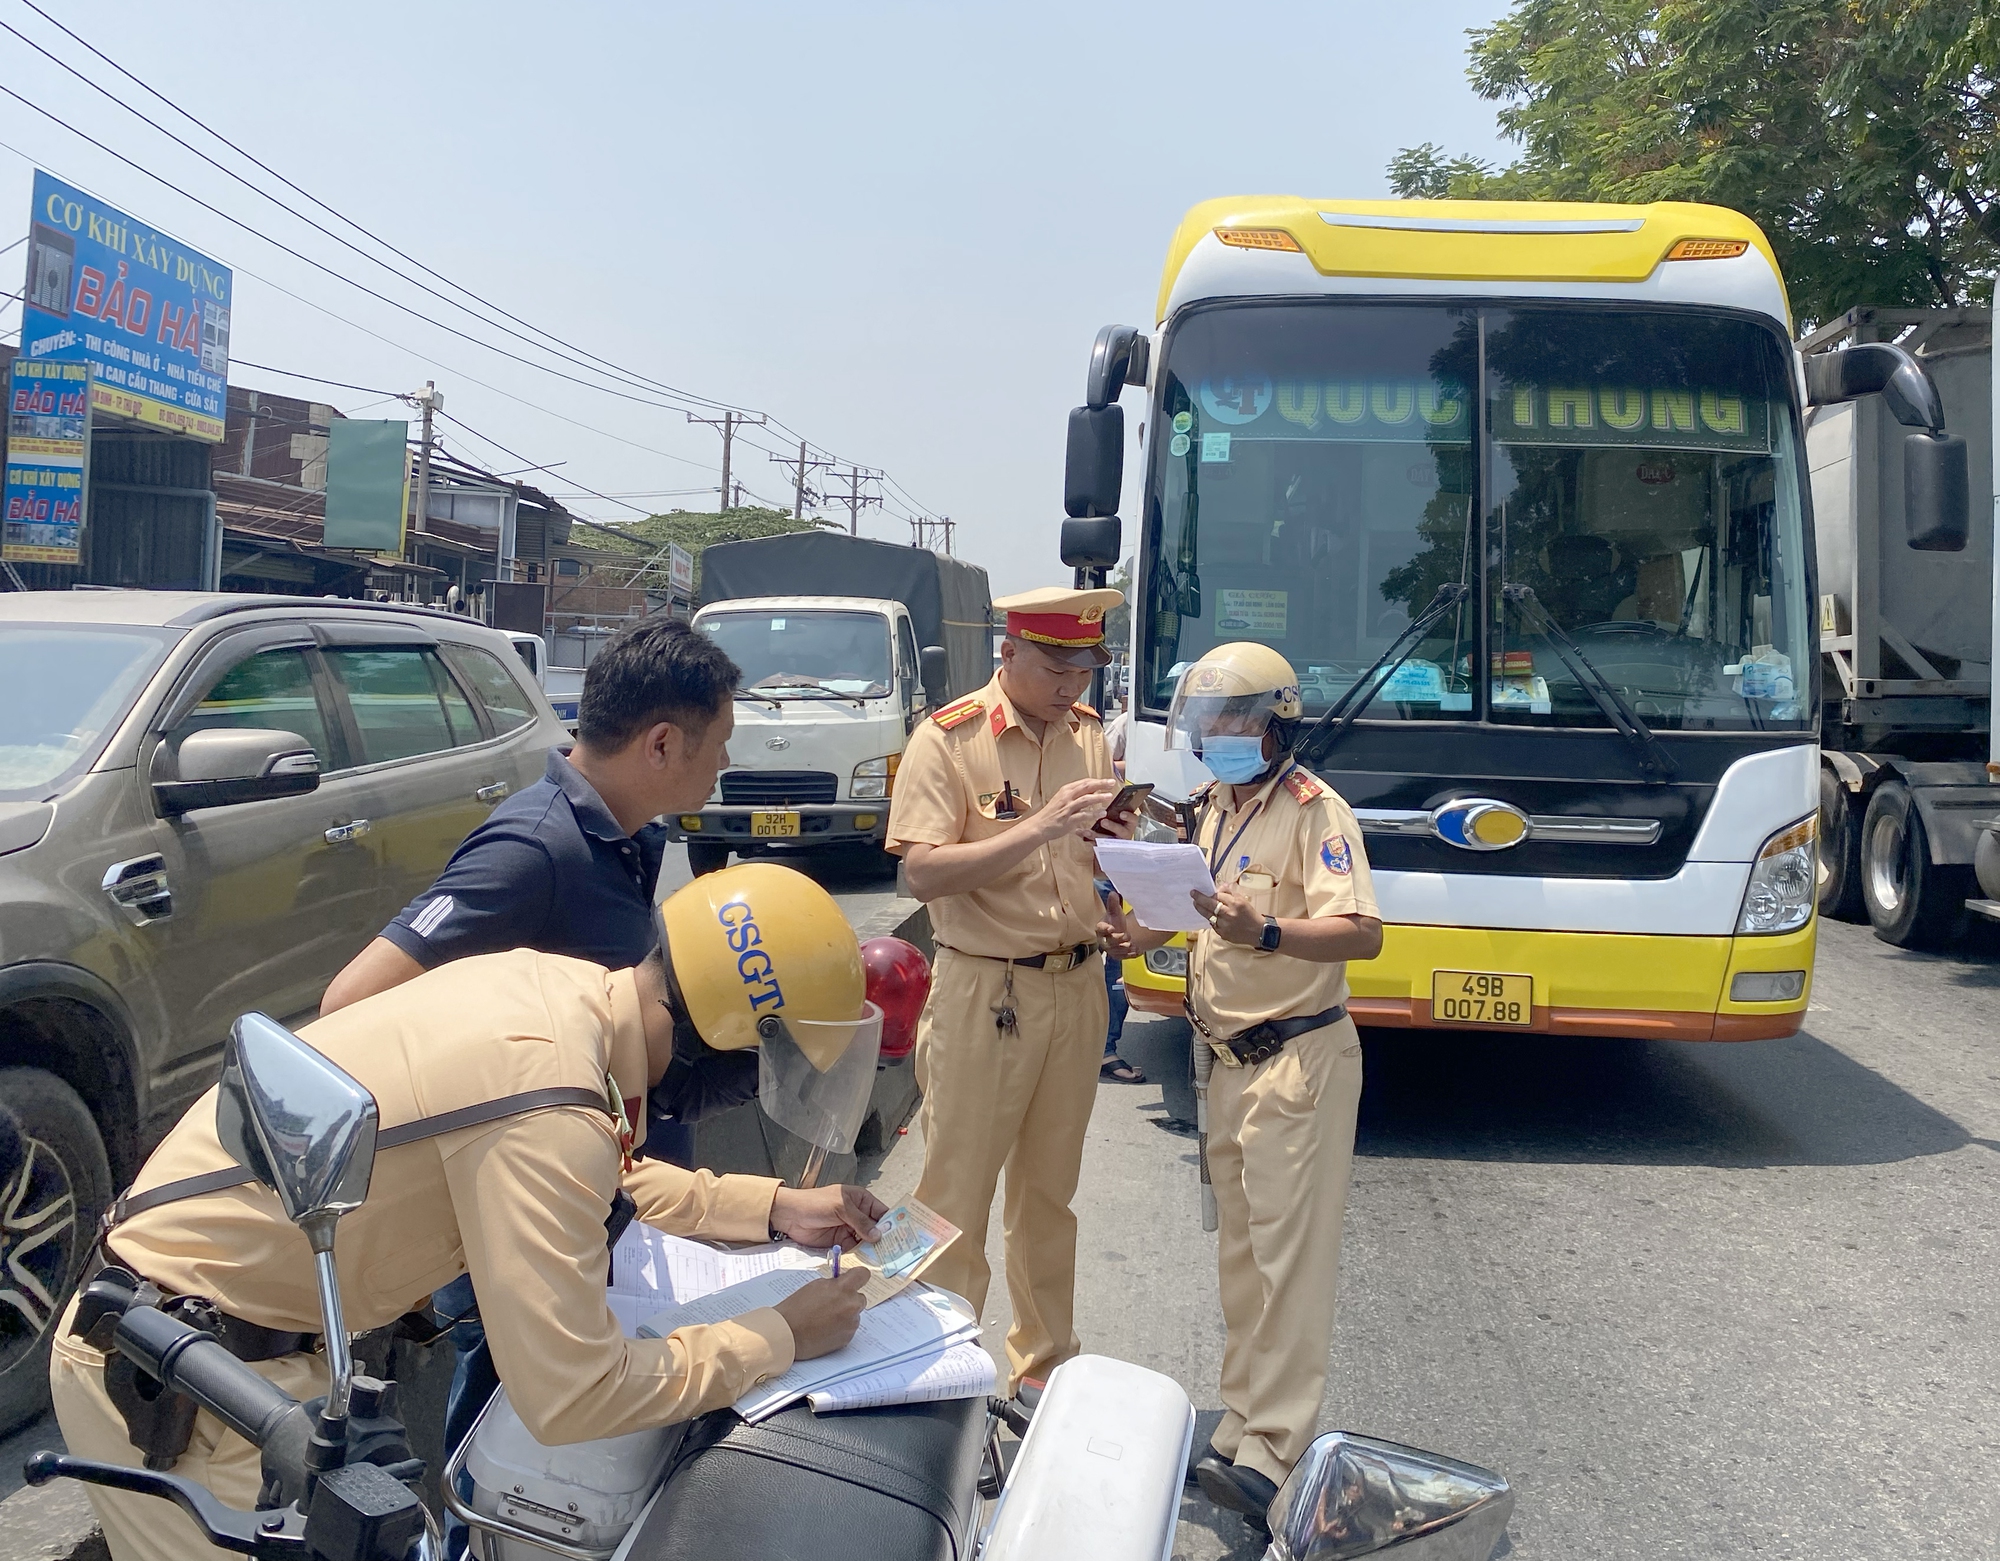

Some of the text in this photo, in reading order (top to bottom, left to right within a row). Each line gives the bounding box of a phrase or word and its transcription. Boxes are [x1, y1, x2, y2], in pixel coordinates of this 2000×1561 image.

[46, 193, 225, 300] CƠ KHÍ XÂY DỰNG
[74, 261, 201, 357] BẢO HÀ
[31, 329, 77, 357] CHUYÊN:
[85, 333, 101, 353] THI
[103, 337, 130, 362] CÔNG
[132, 349, 151, 370] NHÀ
[167, 362, 185, 381] NHÀ
[44, 361, 61, 379] XÂY
[13, 381, 55, 415] BẢO
[58, 387, 86, 417] HÀ
[105, 365, 127, 385] CAN
[149, 379, 177, 401] THANG
[39, 469, 56, 487] XÂY
[7, 489, 80, 524] BẢO HÀ
[1283, 685, 1300, 703] CS
[765, 814, 787, 824] 92H
[718, 900, 785, 1012] CSGT
[1462, 975, 1504, 997] 49B
[1443, 998, 1521, 1022] 007.88
